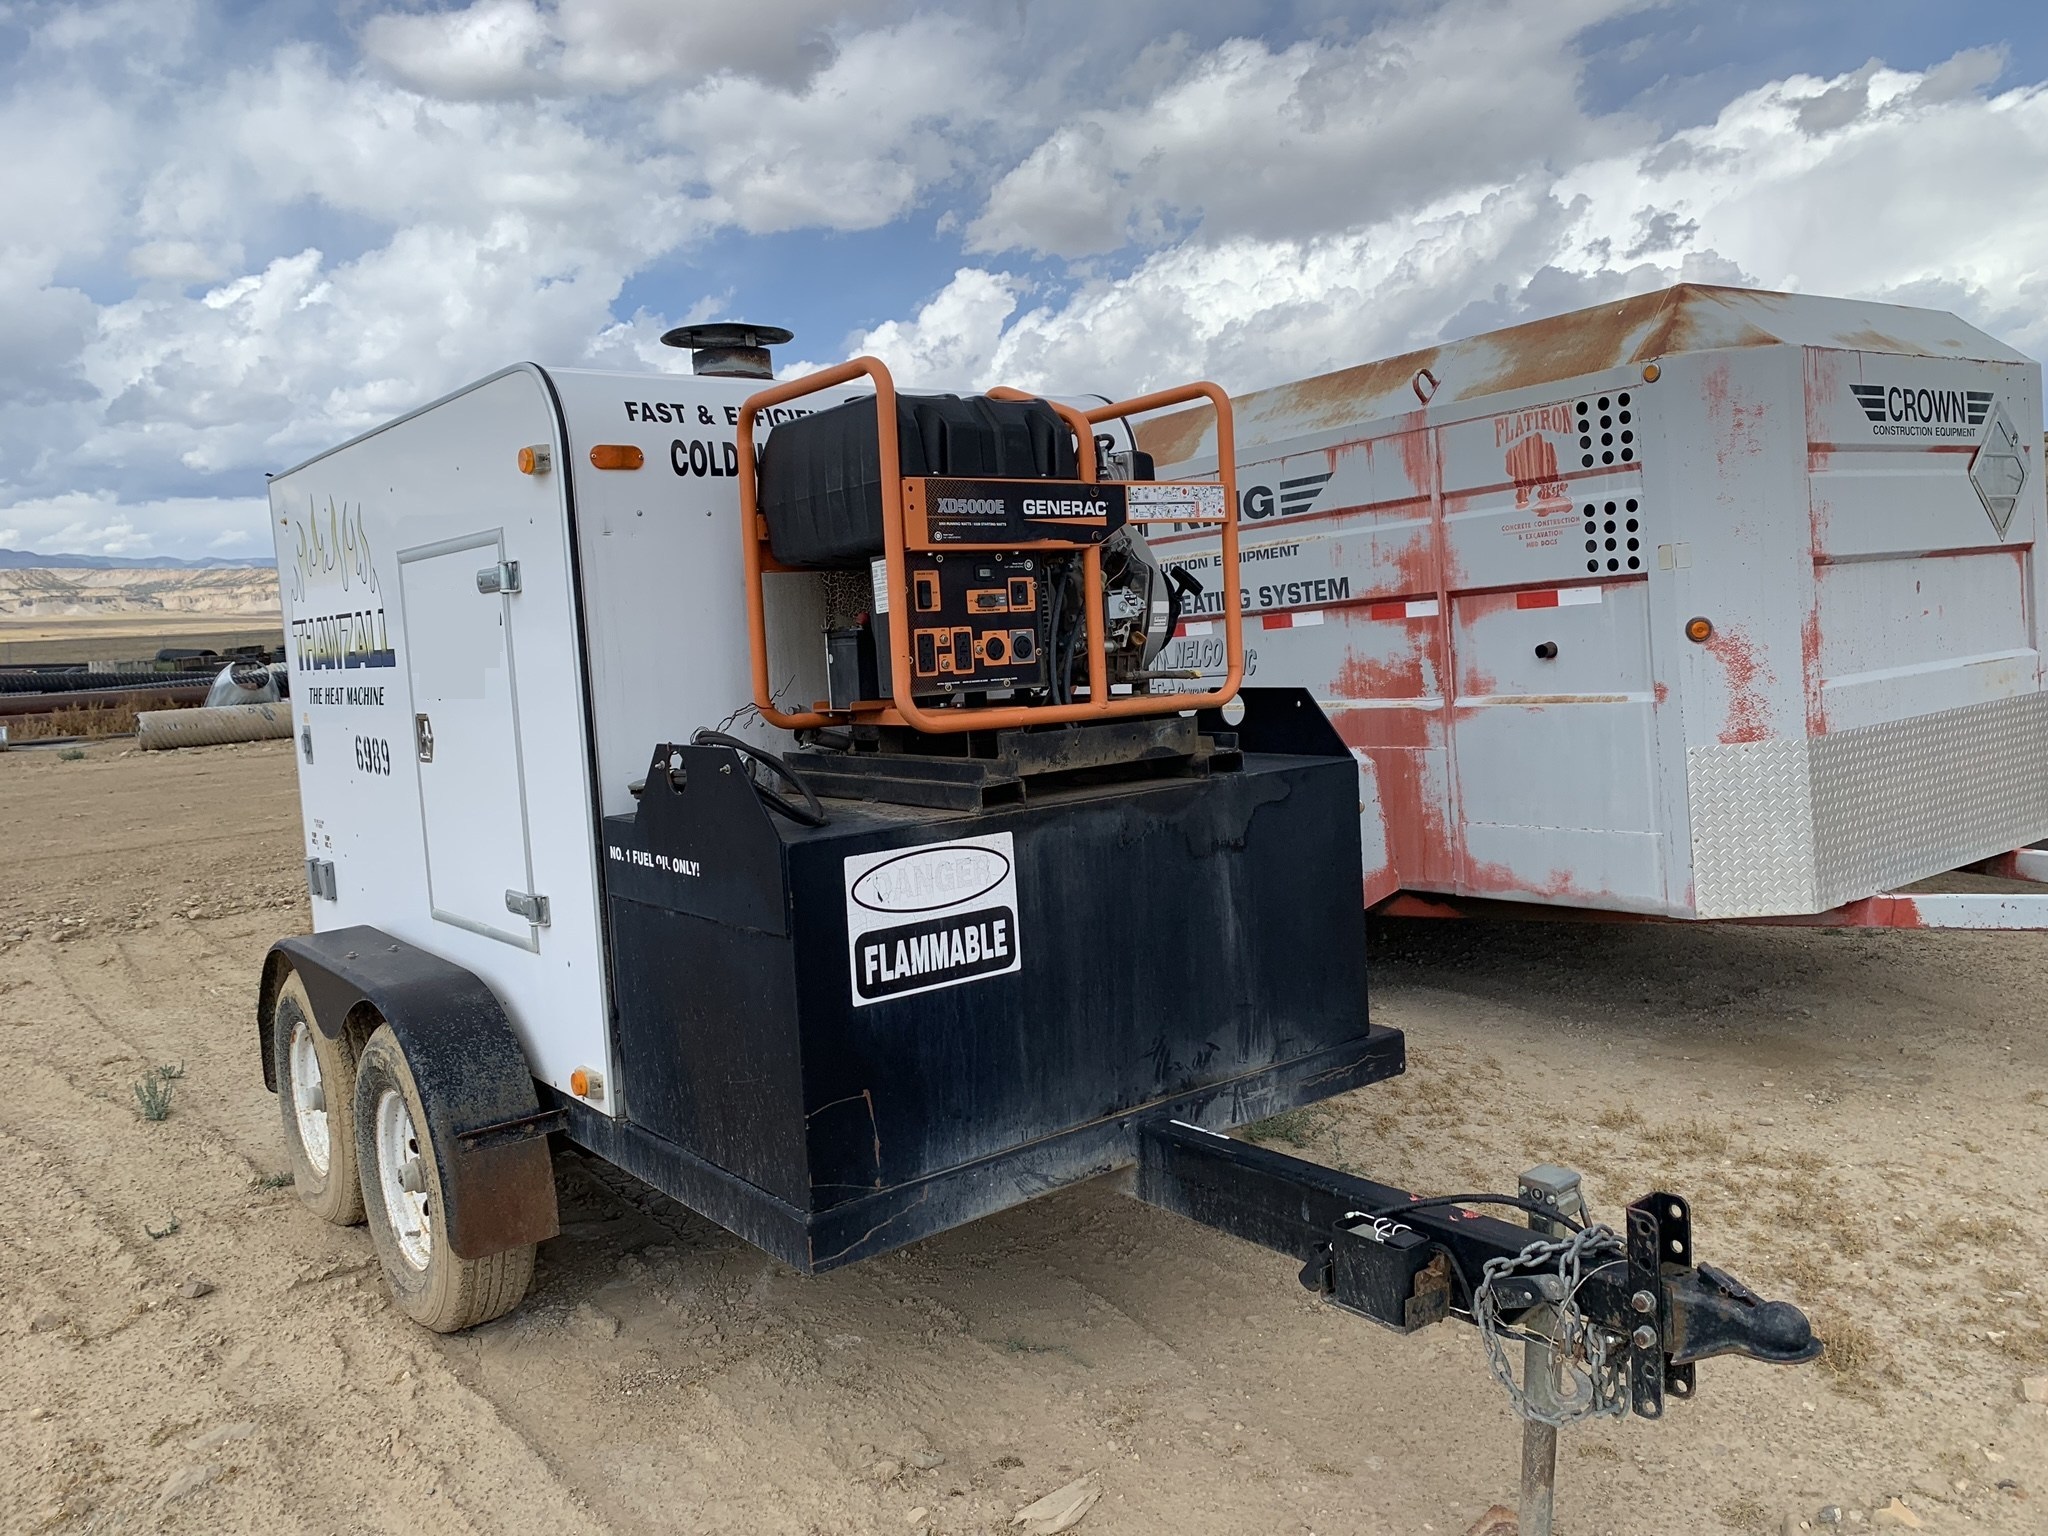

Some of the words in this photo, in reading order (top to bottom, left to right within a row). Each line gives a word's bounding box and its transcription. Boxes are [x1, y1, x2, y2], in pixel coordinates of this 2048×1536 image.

[624, 401, 685, 424] FAST
[697, 405, 716, 425] &
[1888, 386, 1966, 424] CROWN
[1494, 404, 1574, 448] FLATIRON
[1873, 425, 1933, 437] CONSTRUCTION
[1935, 426, 1976, 438] EQUIPMENT
[671, 439, 739, 478] COLD
[937, 498, 1005, 514] XD5000E
[1023, 499, 1107, 515] GENERAC
[1501, 522, 1531, 533] CONCRETE
[1534, 516, 1580, 528] CONSTRUCTION
[1213, 544, 1300, 567] EIPMENT
[1181, 588, 1251, 615] EATIG
[1259, 576, 1350, 608] SYSTEM
[292, 608, 396, 671] THAWZALL
[1175, 638, 1224, 669] NELCO
[309, 687, 322, 705] THE
[324, 687, 344, 705] HEAT
[346, 686, 385, 706] MACHINE
[355, 734, 391, 777] 6989
[609, 845, 624, 861] NO.
[625, 848, 631, 863] 1
[632, 850, 655, 868] FUEL
[672, 857, 700, 878] ONLY!
[864, 918, 1008, 986] FLAMMABLE
